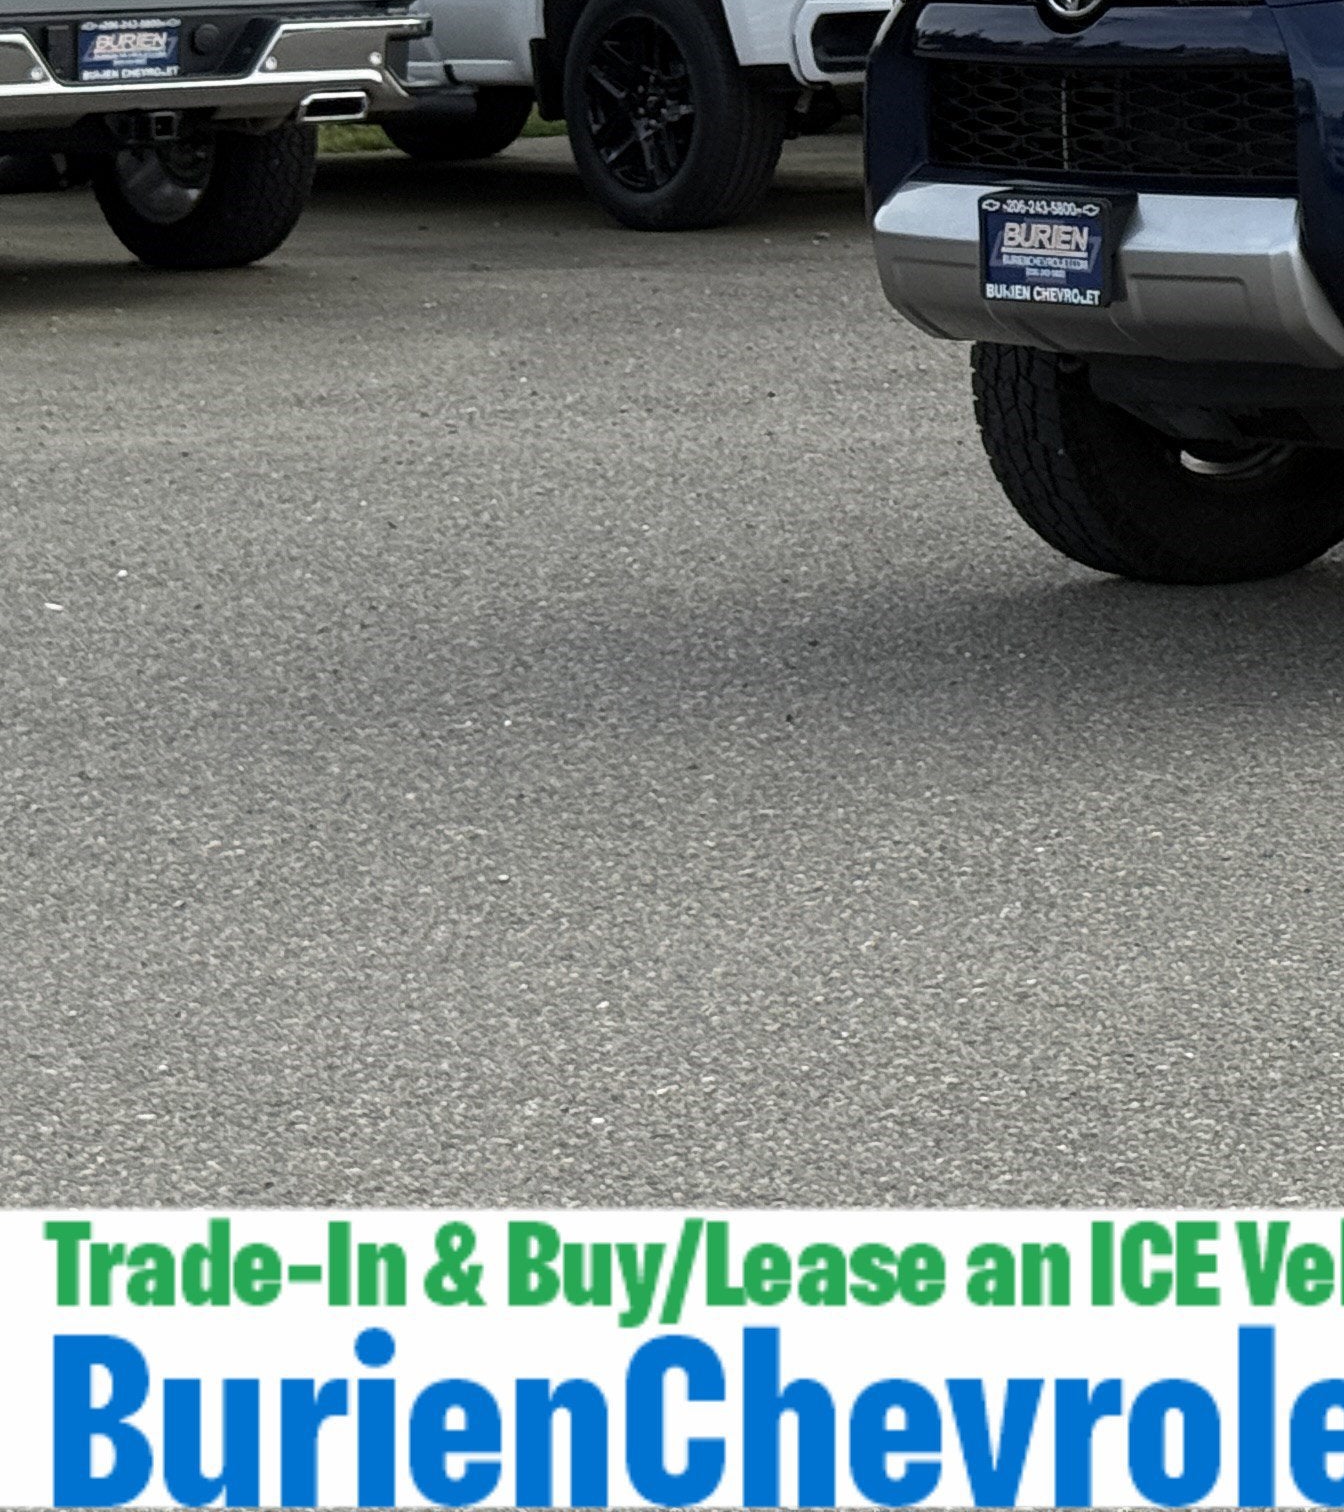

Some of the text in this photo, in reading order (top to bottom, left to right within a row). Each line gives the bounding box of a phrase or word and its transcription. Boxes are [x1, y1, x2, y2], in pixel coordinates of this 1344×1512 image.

[95, 32, 167, 50] BURIEN
[1003, 222, 1089, 251] BURIEN
[986, 283, 1101, 305] BURIEN CHEVROLET
